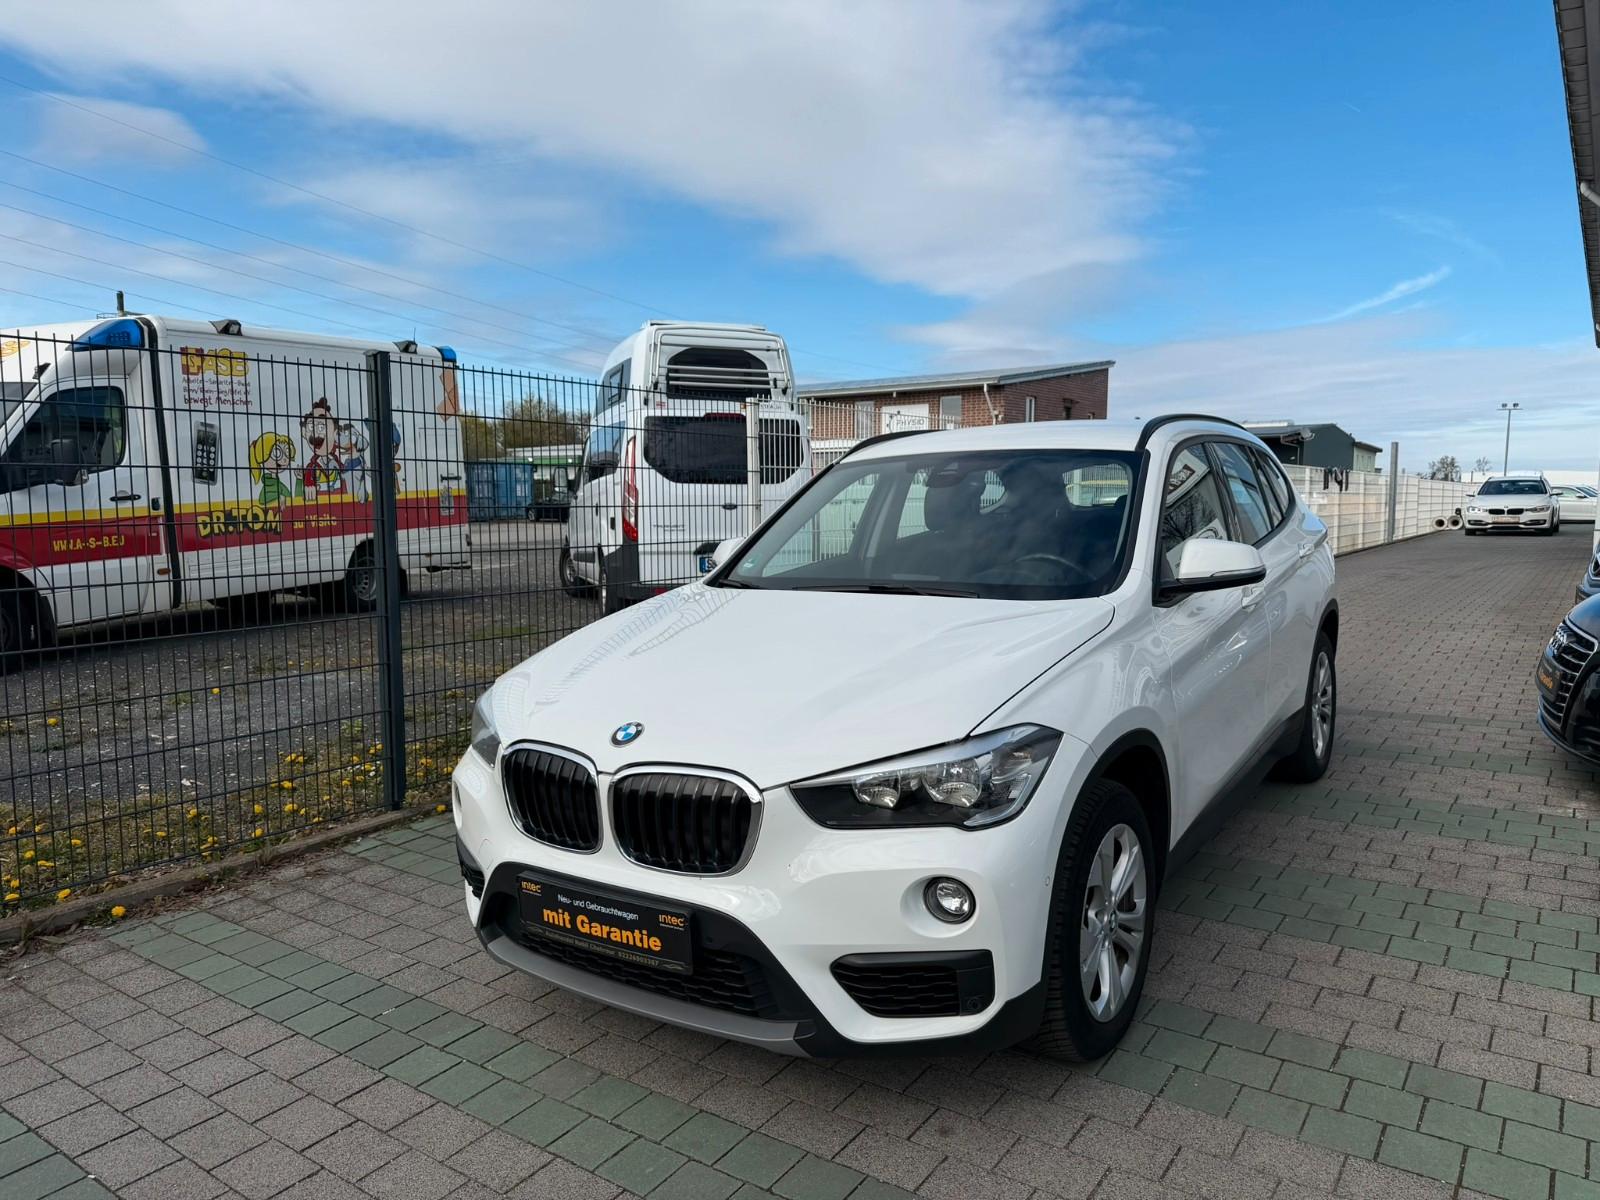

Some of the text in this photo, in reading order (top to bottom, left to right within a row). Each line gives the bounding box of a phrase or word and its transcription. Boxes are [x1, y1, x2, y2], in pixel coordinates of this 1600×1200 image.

[521, 880, 541, 893] intec
[557, 893, 639, 920] Neu- und Gebrauchtwagen
[543, 908, 571, 929] mit
[576, 914, 662, 951] Garantie
[658, 914, 684, 927] intec
